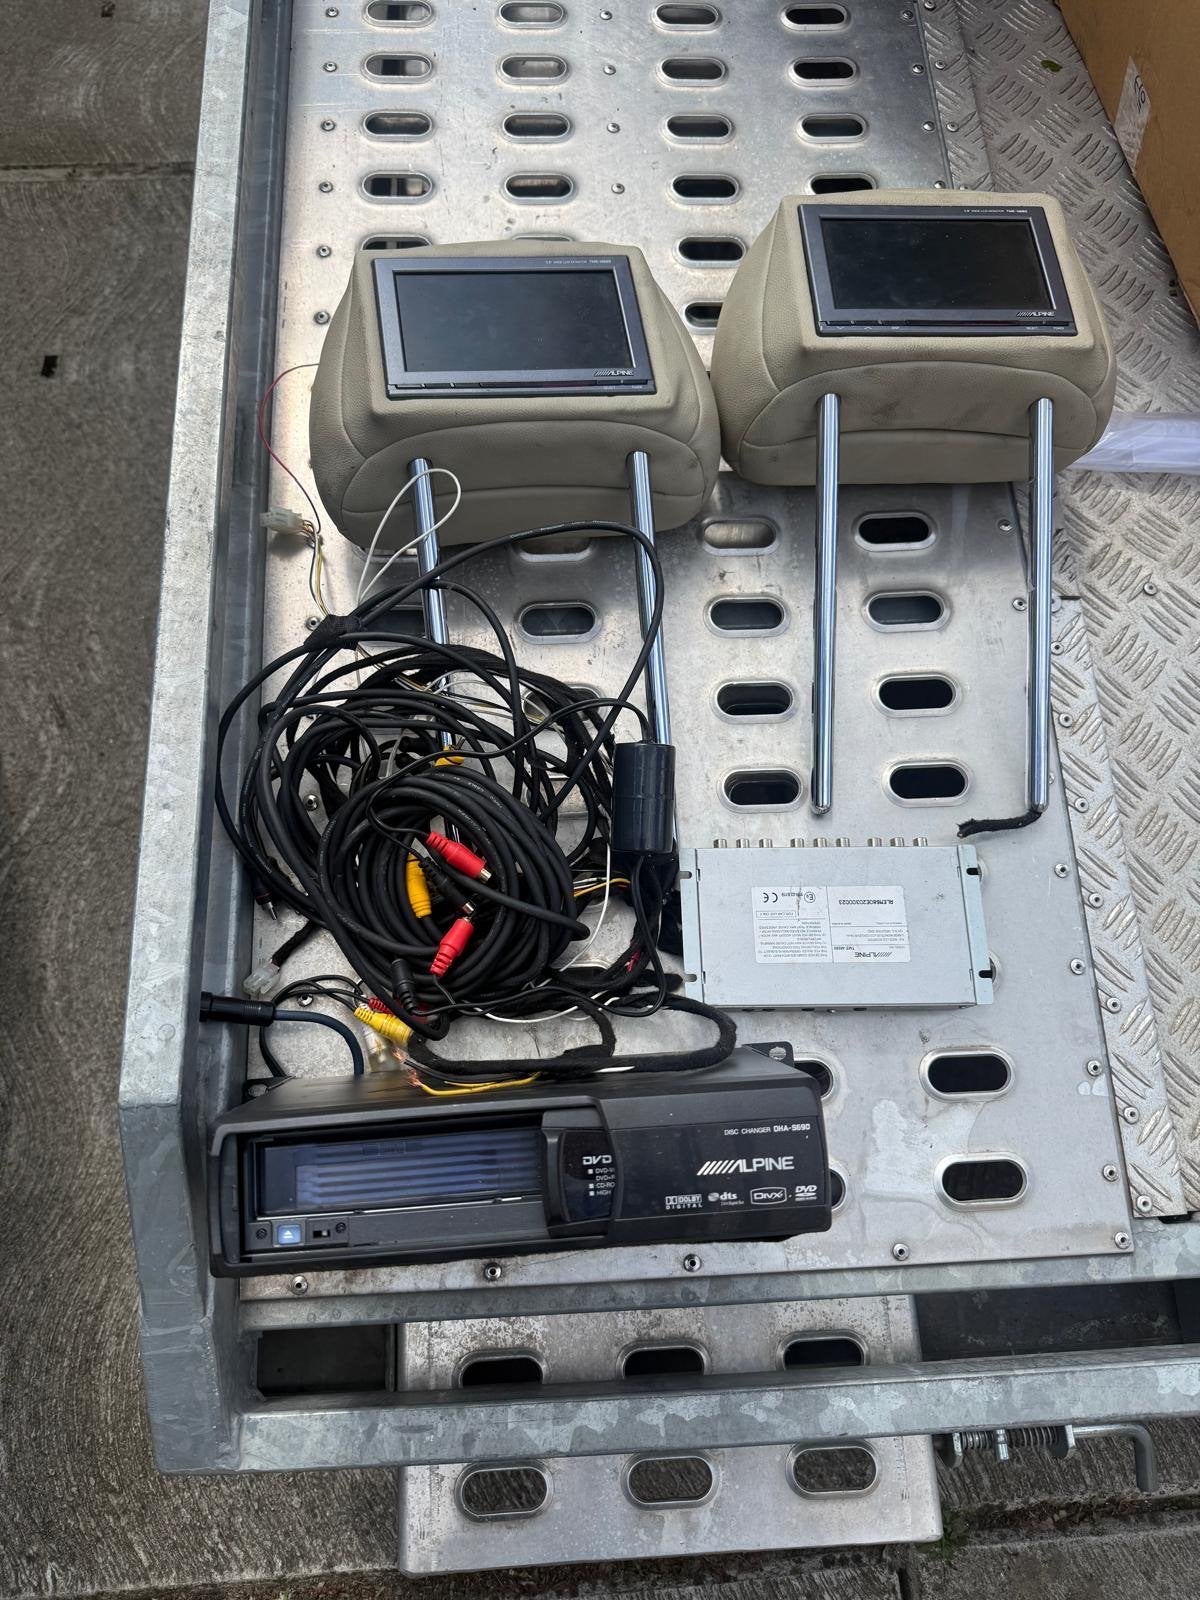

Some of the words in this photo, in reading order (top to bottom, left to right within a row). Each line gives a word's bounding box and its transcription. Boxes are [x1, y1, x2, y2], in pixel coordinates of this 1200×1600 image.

[723, 1128, 739, 1136] DISC
[741, 1126, 771, 1135] CHANGER
[582, 1154, 612, 1165] DVD
[726, 1156, 795, 1174] ALPINE
[795, 1184, 818, 1193] DVD
[678, 1194, 702, 1204] DOLBY
[719, 1191, 738, 1200] dts
